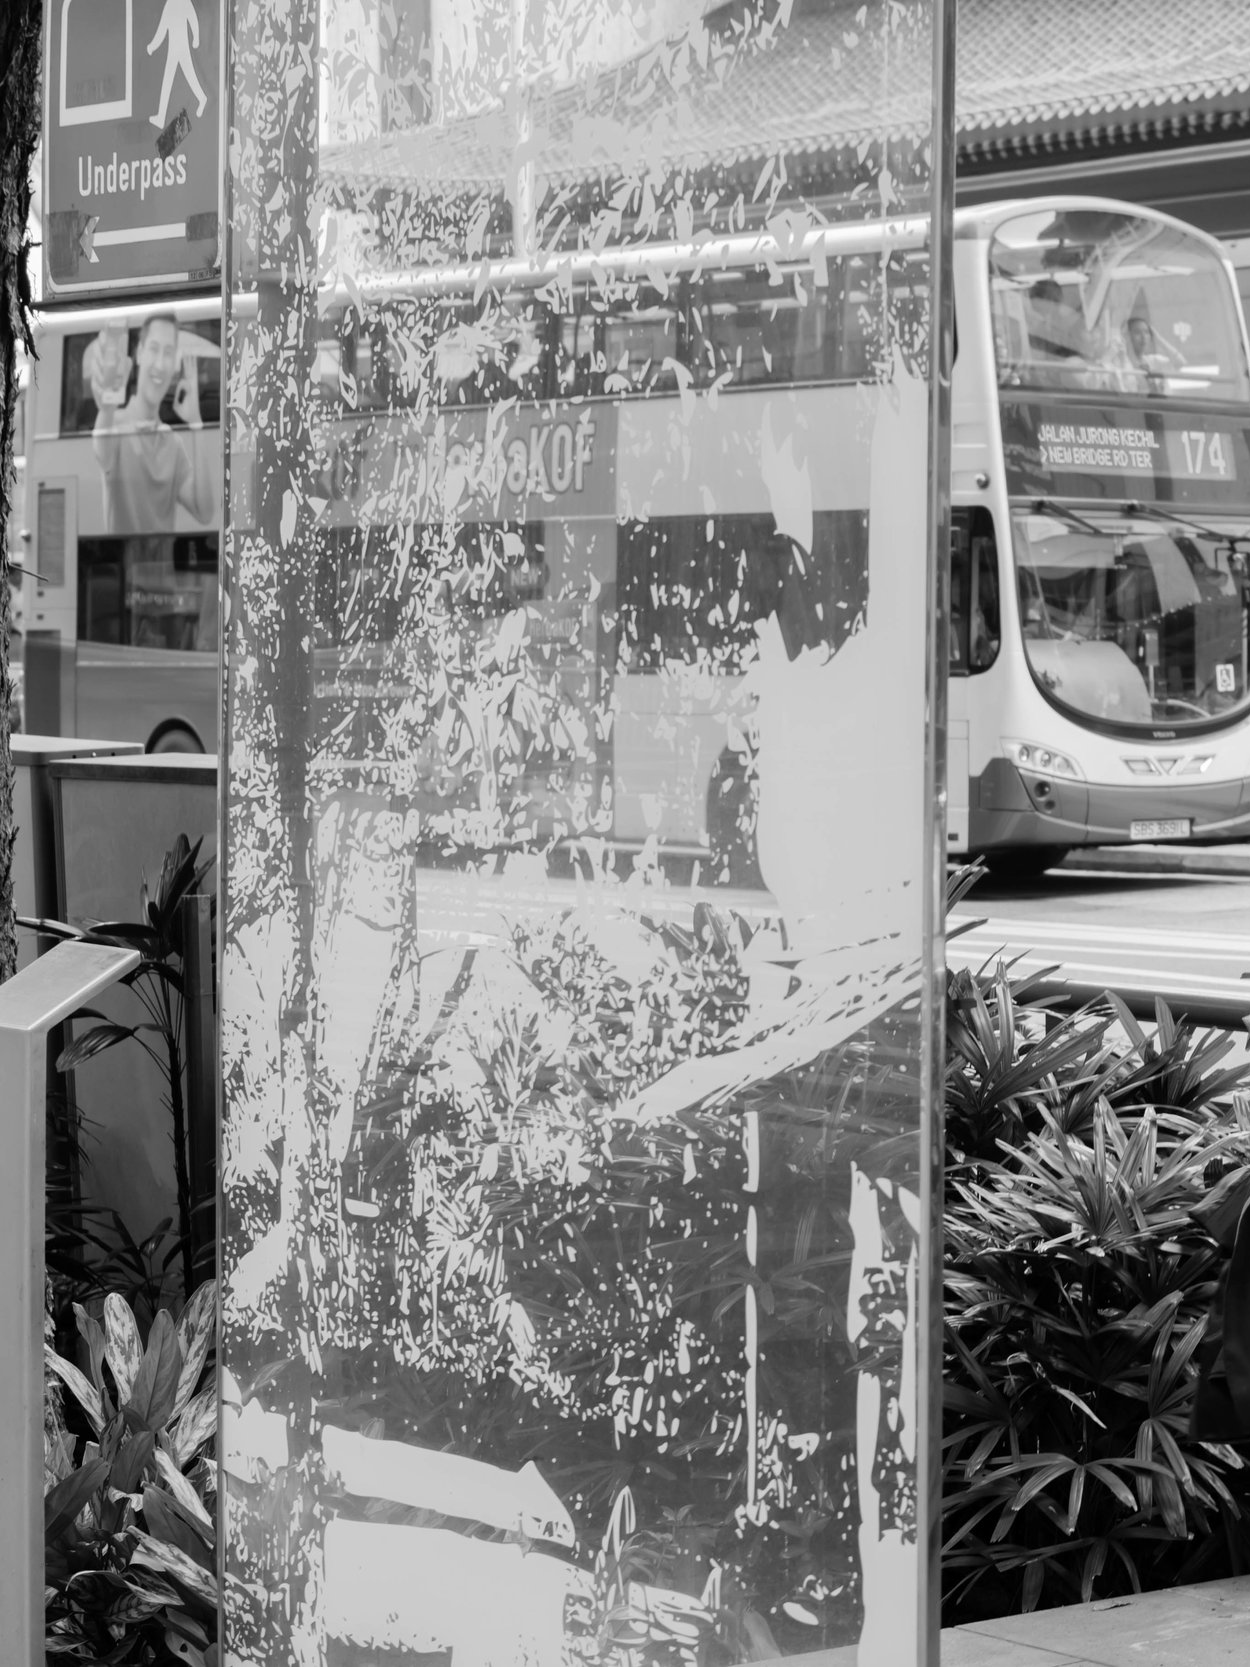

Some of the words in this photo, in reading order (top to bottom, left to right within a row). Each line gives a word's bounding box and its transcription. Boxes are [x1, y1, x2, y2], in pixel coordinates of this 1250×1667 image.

[78, 151, 187, 201] Underpass
[1038, 424, 1076, 444] JALAN
[1076, 426, 1119, 447] JURONG
[1120, 430, 1160, 449] KECHIL
[1049, 446, 1073, 464] NEW
[1073, 447, 1113, 466] BRIDGE
[1114, 450, 1129, 467] RD
[1130, 451, 1153, 468] TER
[1181, 429, 1227, 475] 174
[511, 568, 540, 587] NEW
